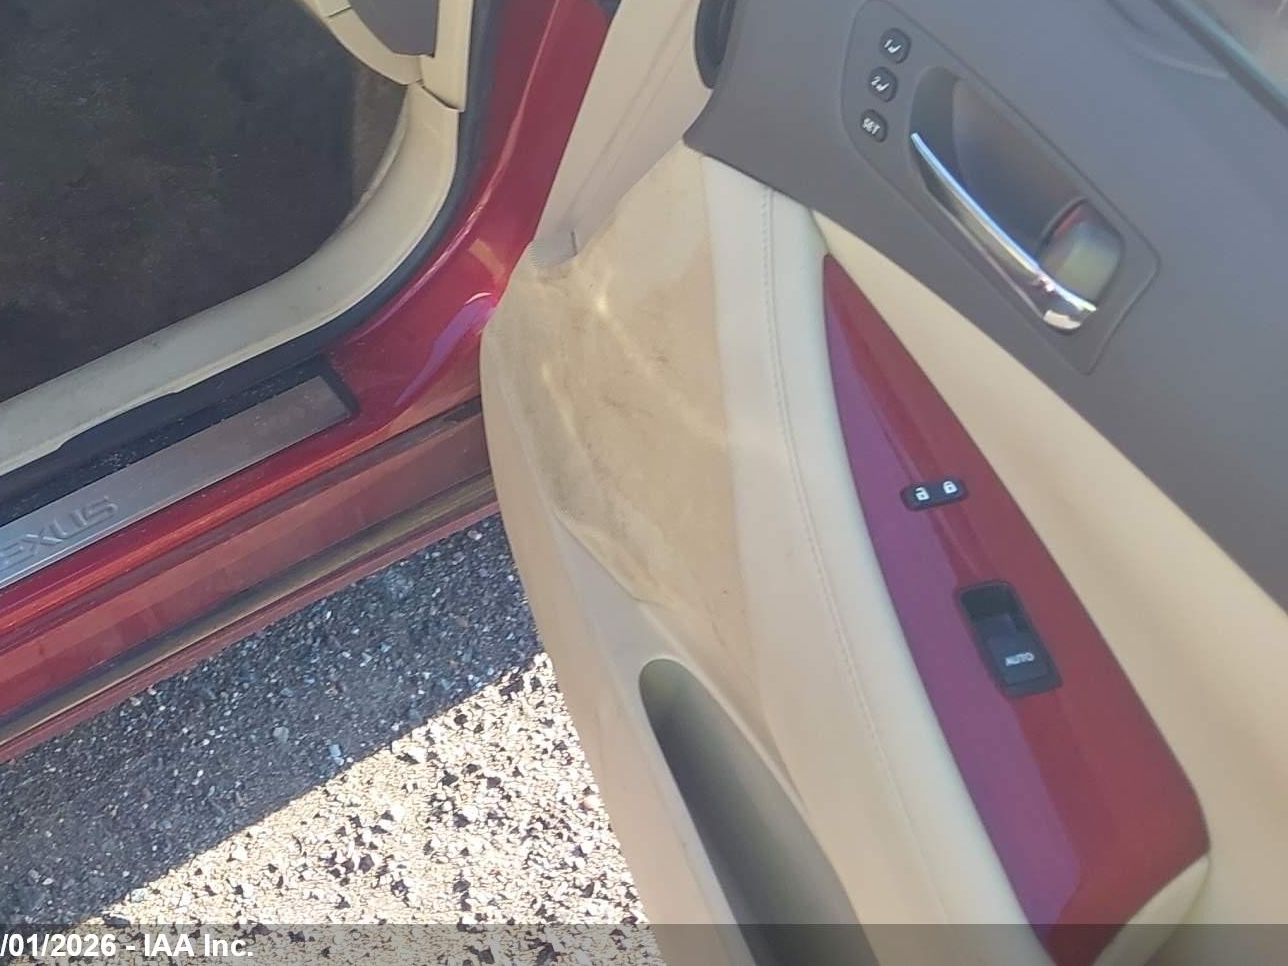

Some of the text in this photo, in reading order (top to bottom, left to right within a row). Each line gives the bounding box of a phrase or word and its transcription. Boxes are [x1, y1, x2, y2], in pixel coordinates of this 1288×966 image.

[871, 76, 882, 86] 2
[863, 118, 880, 134] SET
[1005, 652, 1034, 666] AUTO
